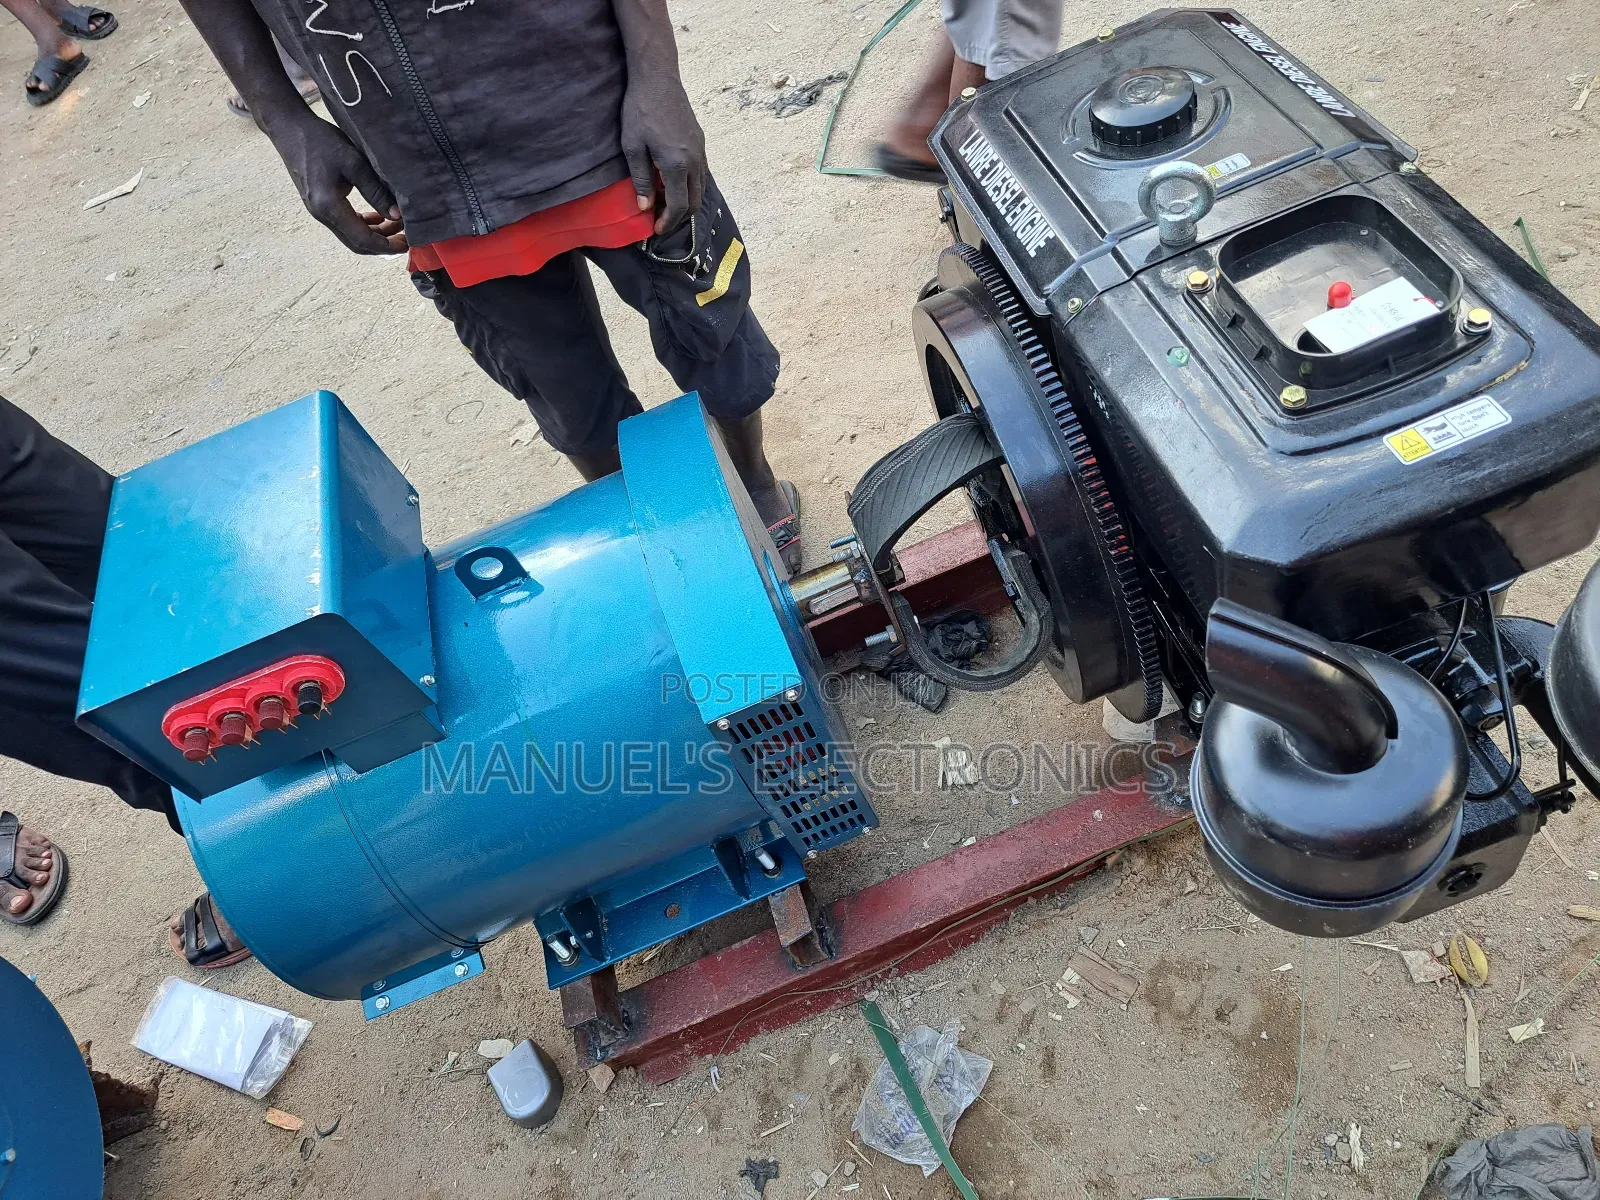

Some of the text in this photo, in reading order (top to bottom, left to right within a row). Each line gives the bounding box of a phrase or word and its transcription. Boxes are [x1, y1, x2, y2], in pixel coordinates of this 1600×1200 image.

[958, 129, 1055, 258] LANRE DIESEL ENGINE
